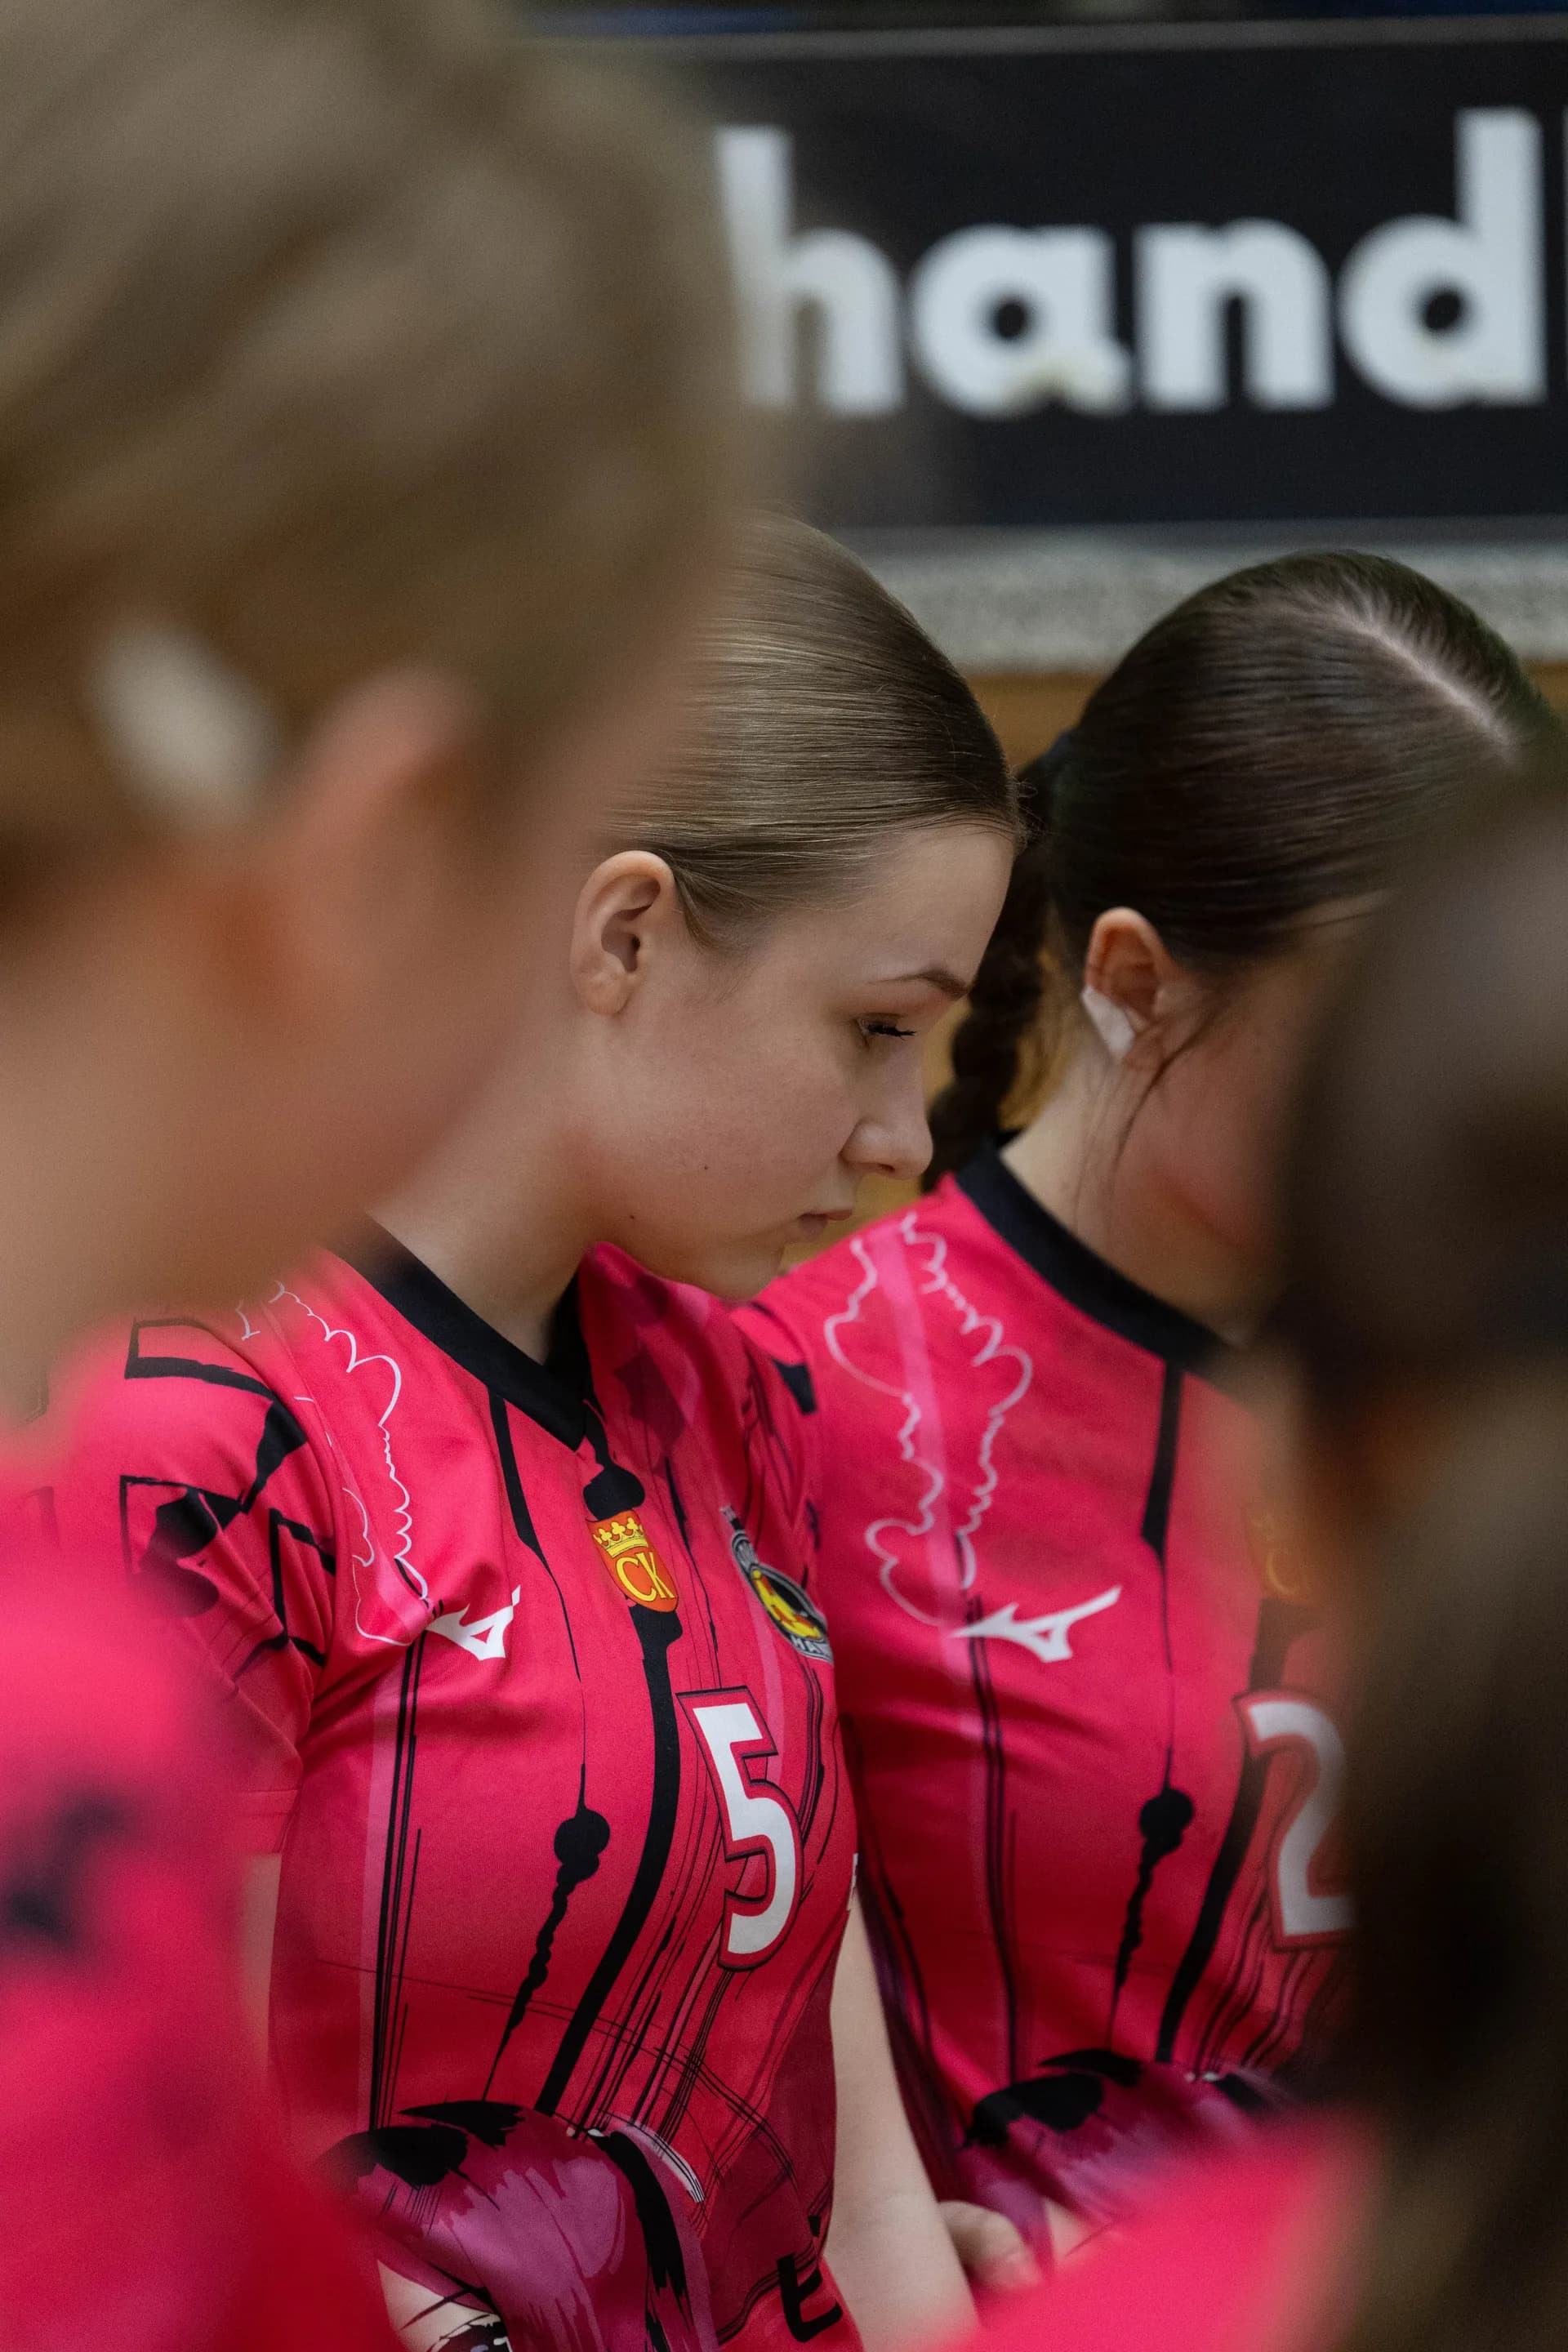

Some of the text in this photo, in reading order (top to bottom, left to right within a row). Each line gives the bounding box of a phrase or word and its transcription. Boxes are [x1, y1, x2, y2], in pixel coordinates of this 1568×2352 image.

[712, 105, 1568, 418] hand
[615, 1551, 675, 1601] CK
[692, 1701, 796, 1955] 5
[1248, 1699, 1357, 1938] 2
